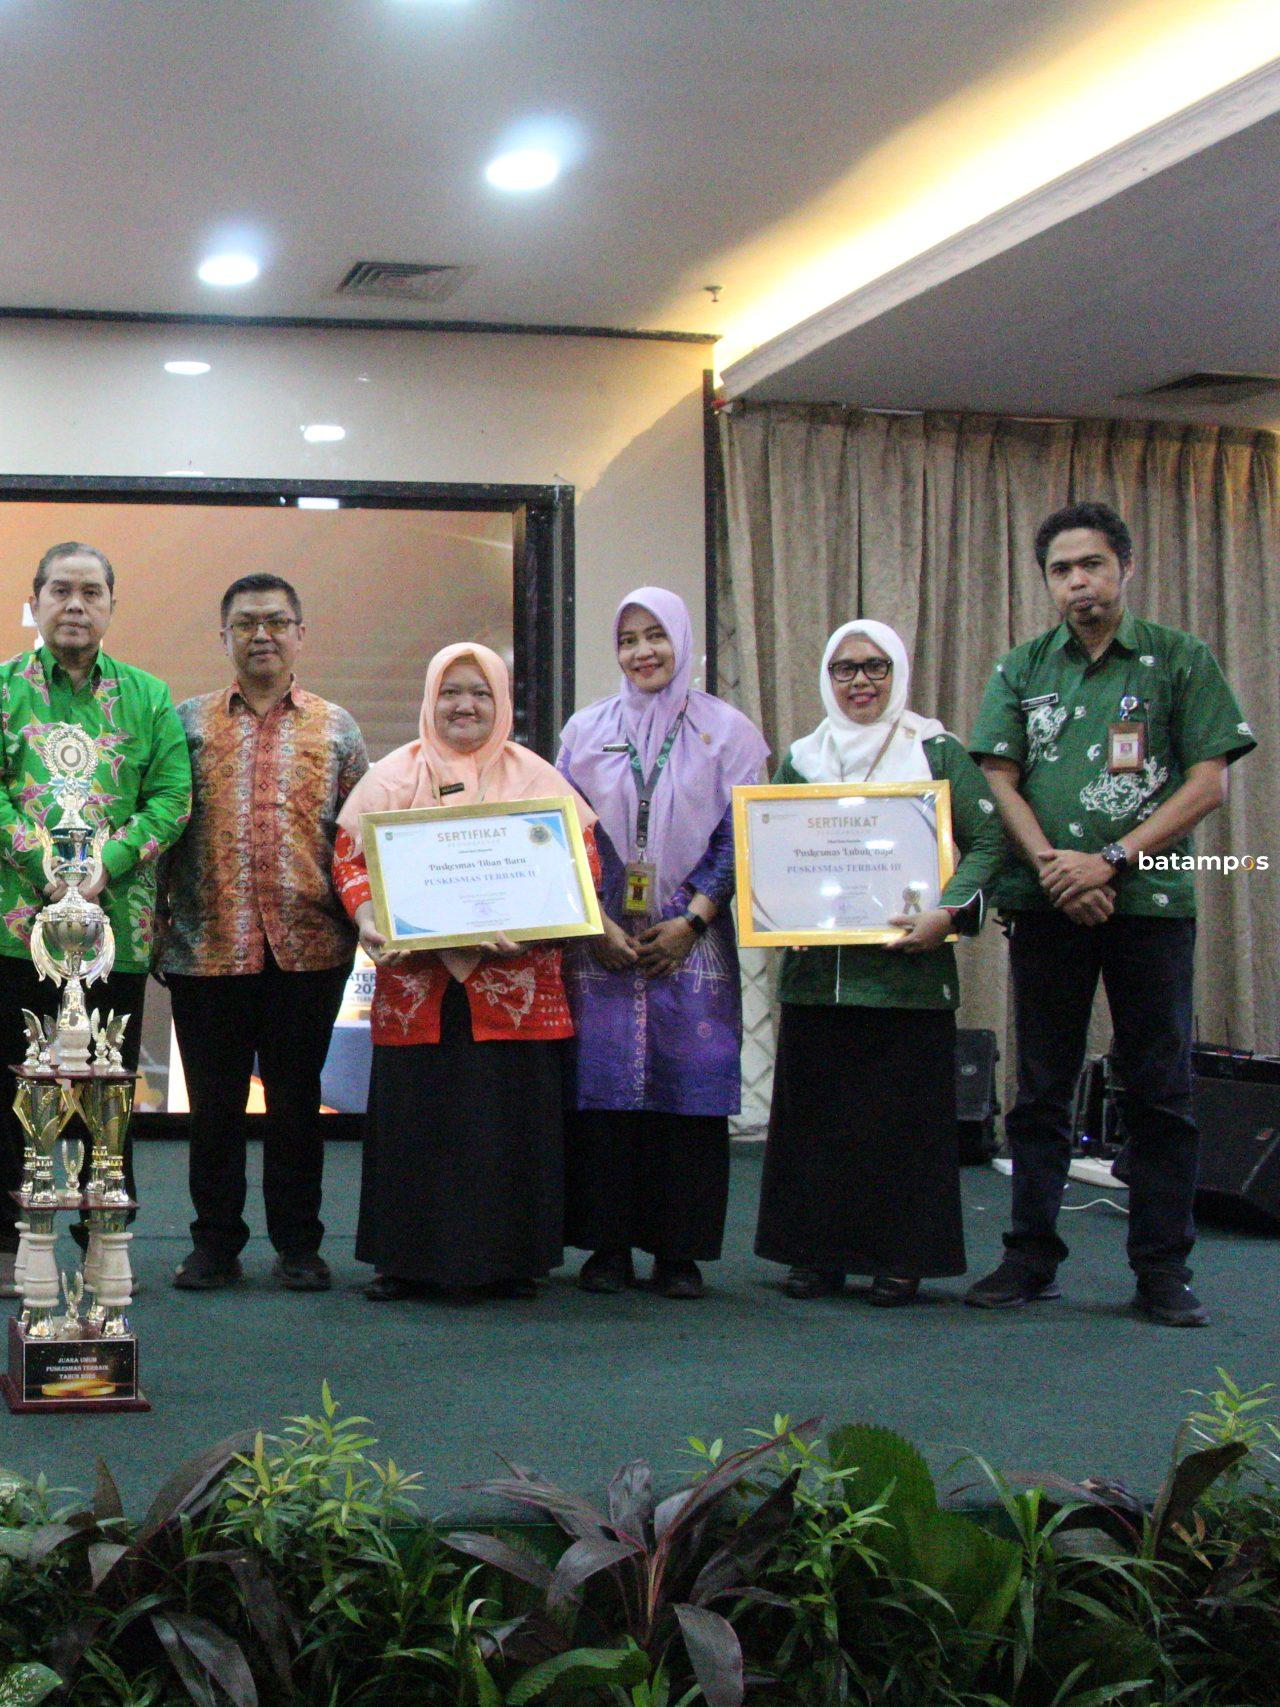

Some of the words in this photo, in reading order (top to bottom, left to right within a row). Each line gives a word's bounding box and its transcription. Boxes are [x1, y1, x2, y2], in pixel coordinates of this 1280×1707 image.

[807, 816, 879, 829] SERTIFIKAT
[437, 827, 507, 842] SERTIFIKAT
[793, 847, 840, 858] Puskesmas
[429, 861, 476, 872] Puskesmas
[787, 864, 845, 874] PUSKESMAS
[847, 863, 889, 873] TERBAIK
[424, 875, 482, 887] PUSKESMAS
[484, 871, 526, 882] TERBAIK
